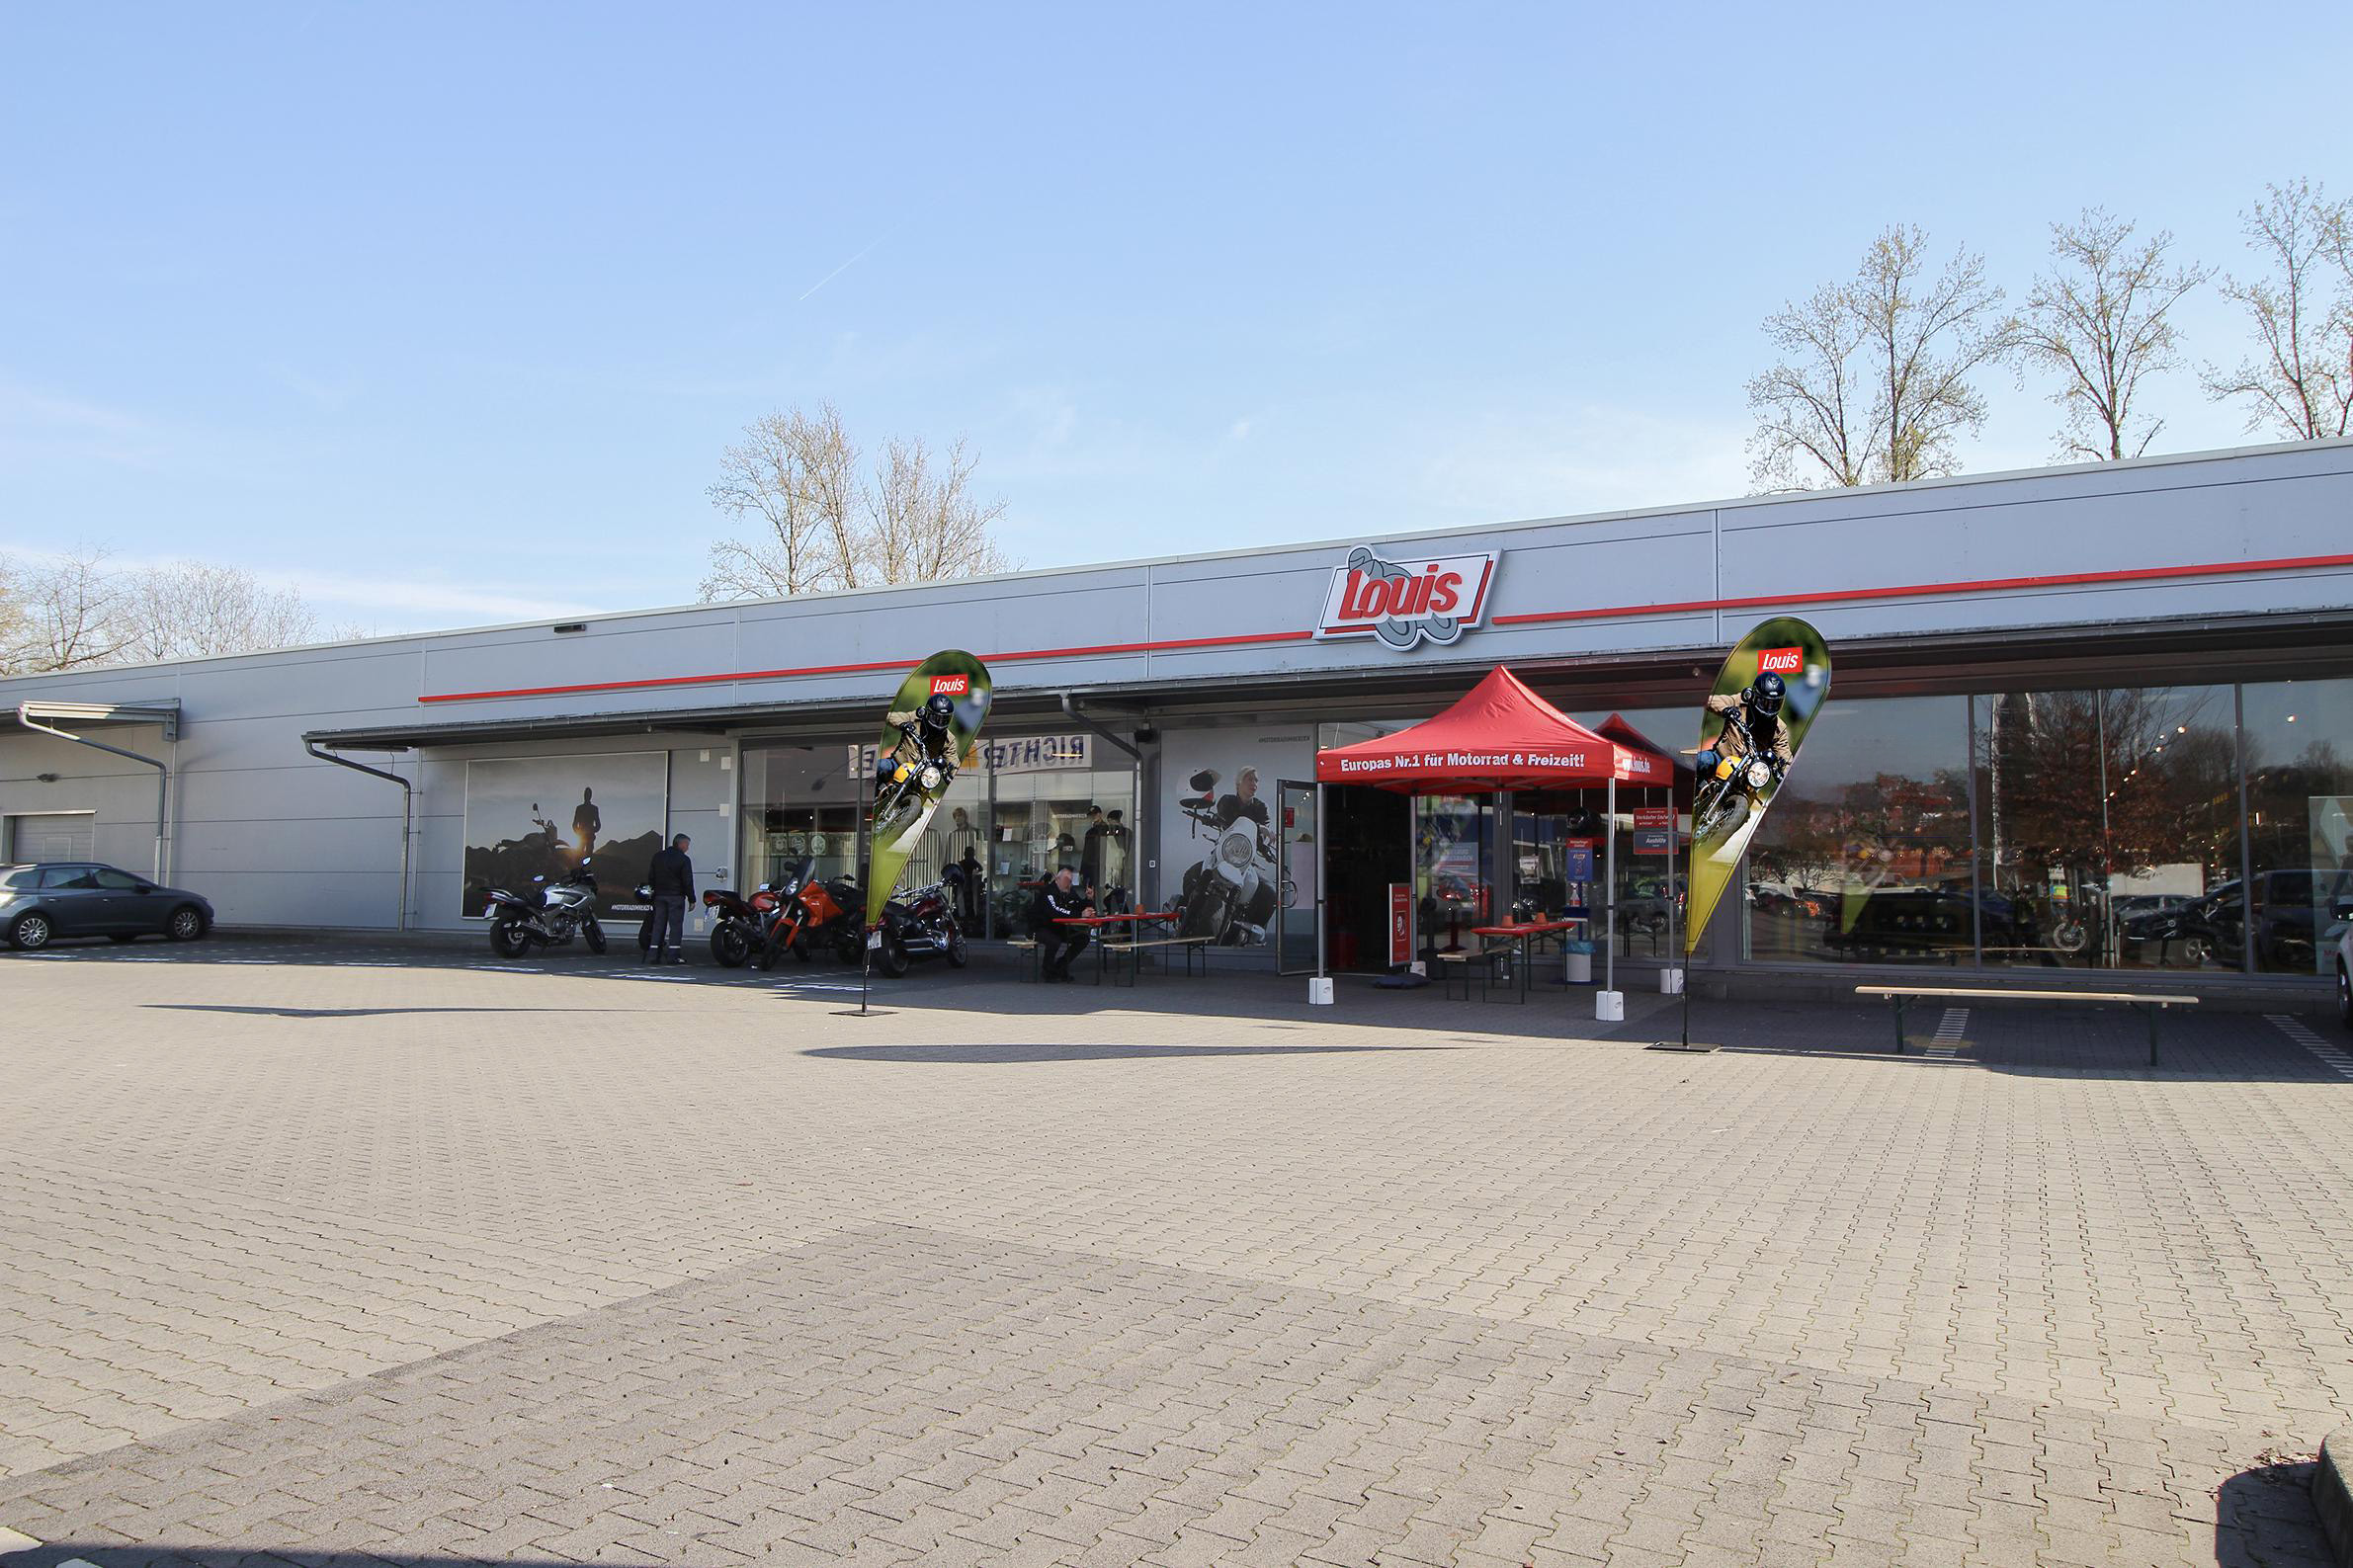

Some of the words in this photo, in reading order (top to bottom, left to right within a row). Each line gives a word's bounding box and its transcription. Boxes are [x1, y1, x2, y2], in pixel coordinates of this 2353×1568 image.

[1338, 564, 1463, 619] Louis
[1762, 652, 1799, 670] Louis
[934, 678, 966, 693] Louis
[1341, 759, 1391, 772] Europas
[1394, 754, 1420, 768] Nr.1
[1424, 753, 1443, 767] für
[1447, 753, 1509, 766] Motorrad
[1512, 754, 1524, 766] &
[1528, 754, 1585, 768] Freizeit!
